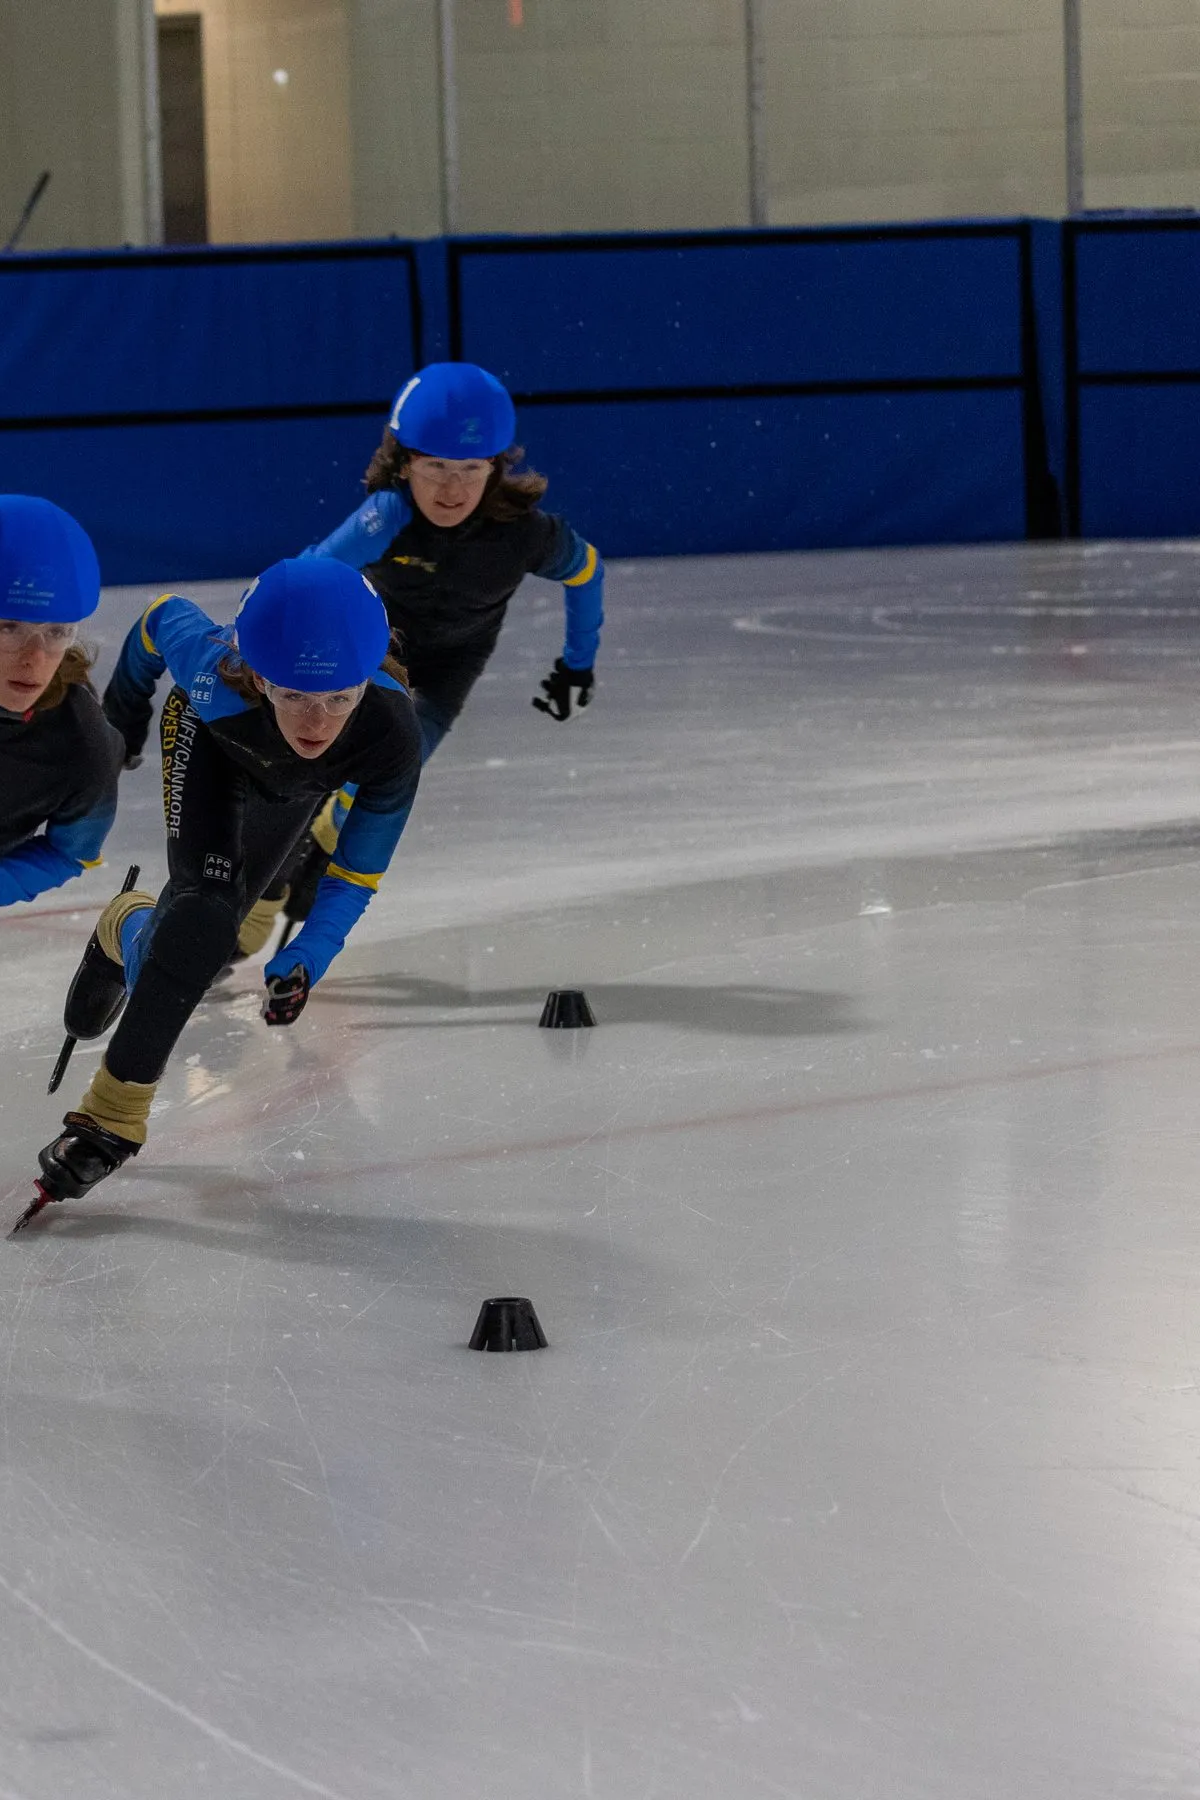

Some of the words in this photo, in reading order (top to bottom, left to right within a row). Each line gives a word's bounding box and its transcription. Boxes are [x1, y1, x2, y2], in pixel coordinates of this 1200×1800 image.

[194, 673, 214, 686] APO
[191, 689, 210, 701] GEE
[207, 856, 231, 869] APO
[205, 868, 229, 879] GEE
